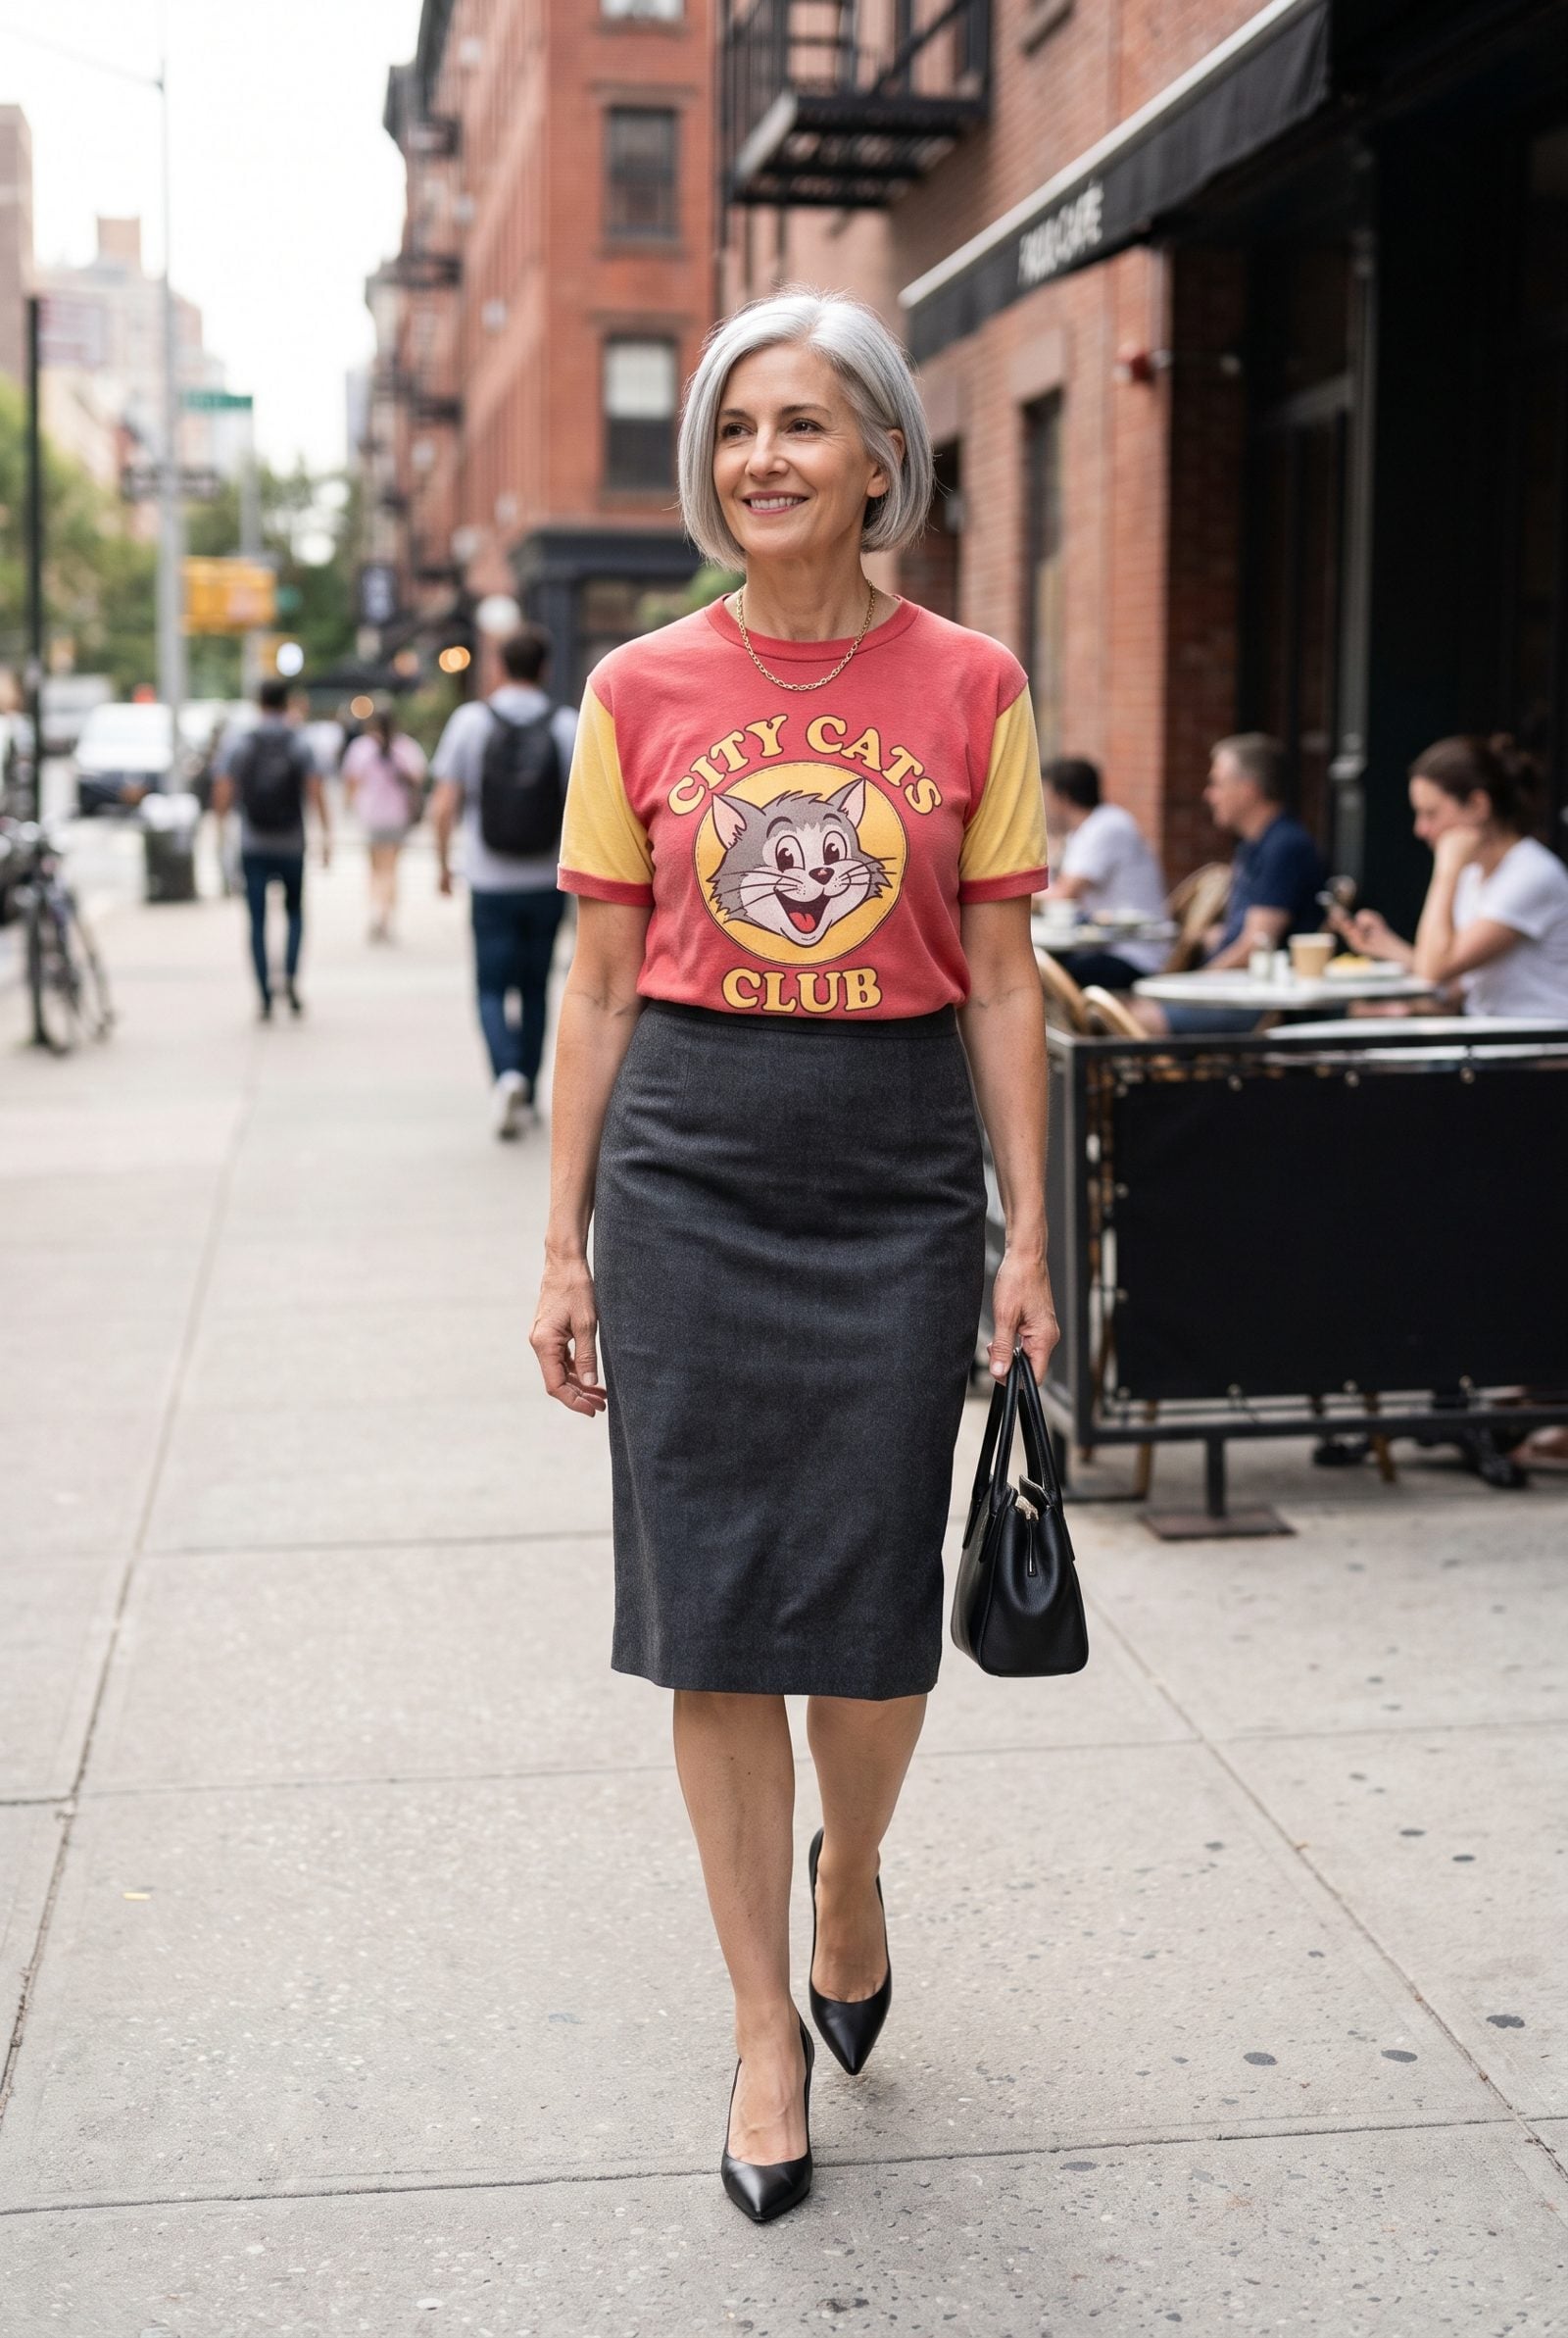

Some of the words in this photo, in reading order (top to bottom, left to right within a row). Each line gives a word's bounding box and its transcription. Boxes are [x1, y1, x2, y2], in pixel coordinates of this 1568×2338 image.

[667, 714, 788, 816] CITY
[806, 715, 943, 816] CATS
[721, 967, 882, 1014] CLUB
